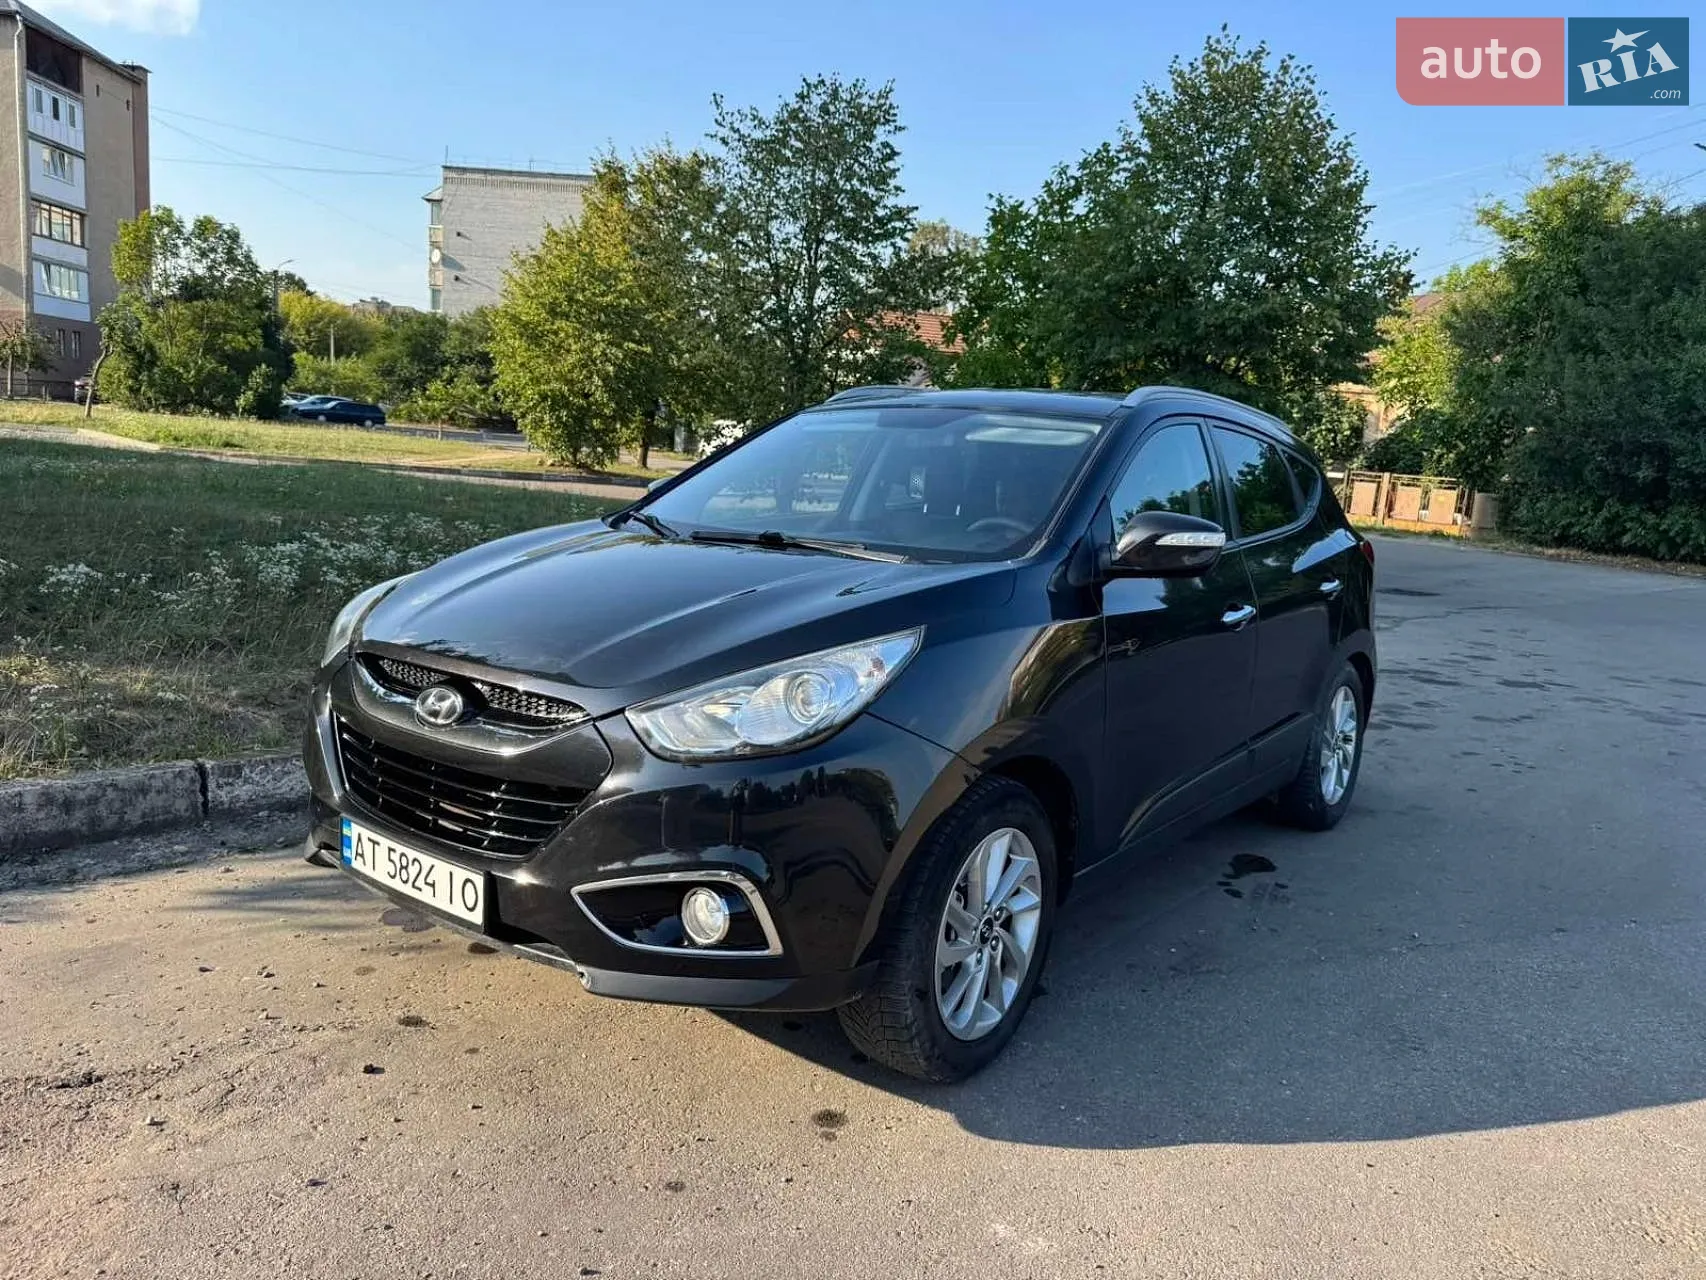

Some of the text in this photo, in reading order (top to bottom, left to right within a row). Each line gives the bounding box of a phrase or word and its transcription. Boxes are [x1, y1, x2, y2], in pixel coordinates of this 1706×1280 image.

[354, 832, 479, 912] AT 5824 IO
